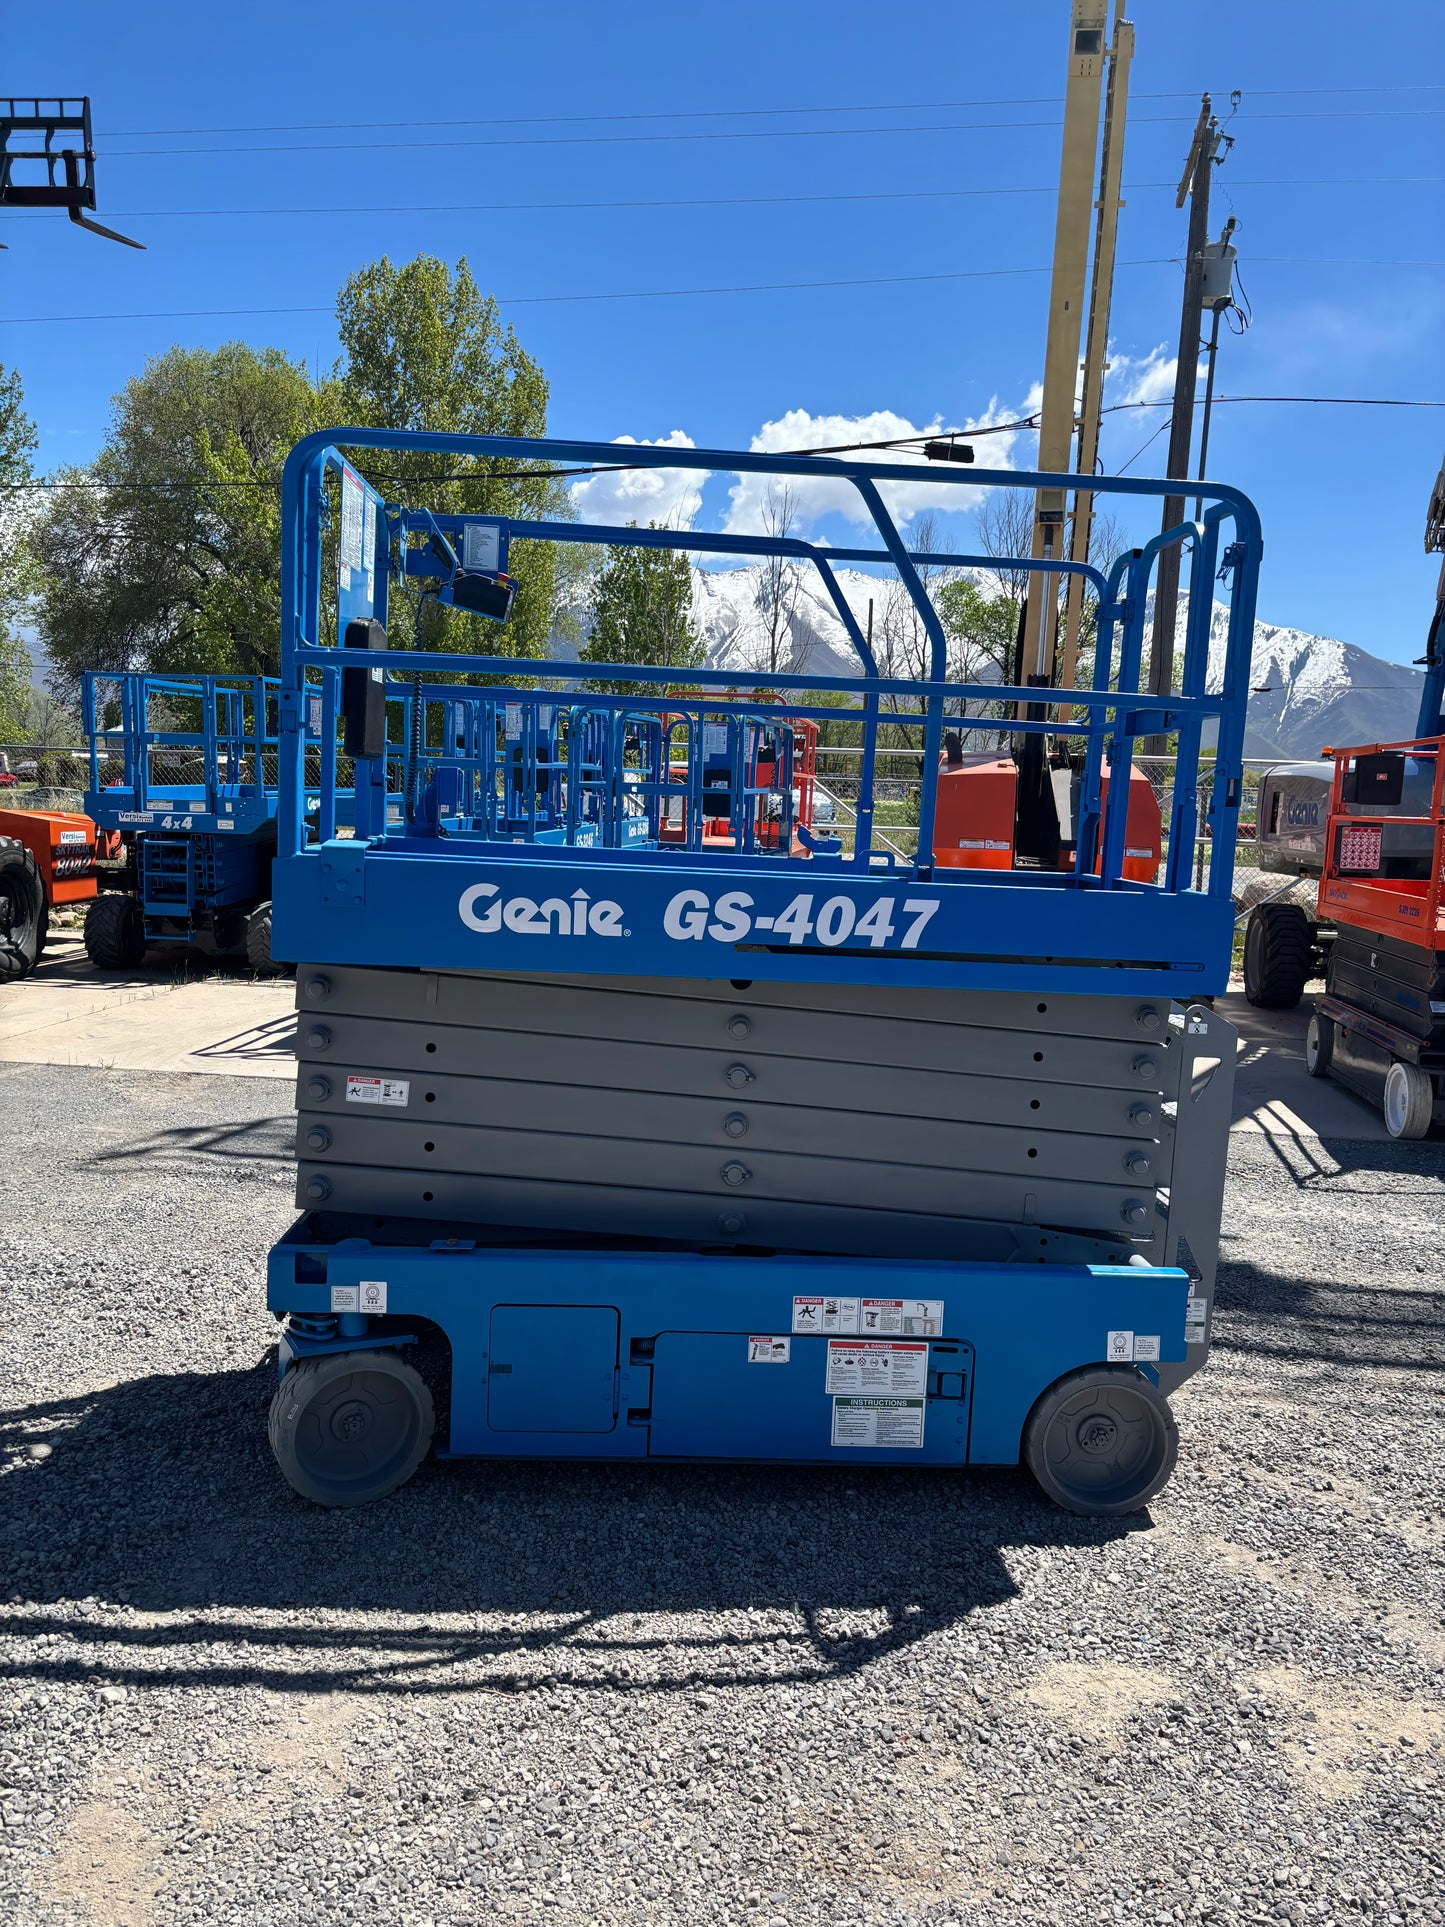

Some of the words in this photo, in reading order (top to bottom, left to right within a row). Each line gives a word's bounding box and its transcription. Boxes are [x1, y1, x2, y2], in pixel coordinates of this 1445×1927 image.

[1287, 795, 1319, 827] Genie
[161, 815, 193, 830] 4x4
[55, 844, 91, 856] SKYTRAK
[55, 856, 92, 877] 8042
[458, 882, 624, 938] Genie
[663, 889, 941, 949] GS-4047
[850, 1399, 908, 1407] INSTRUCTIONS
